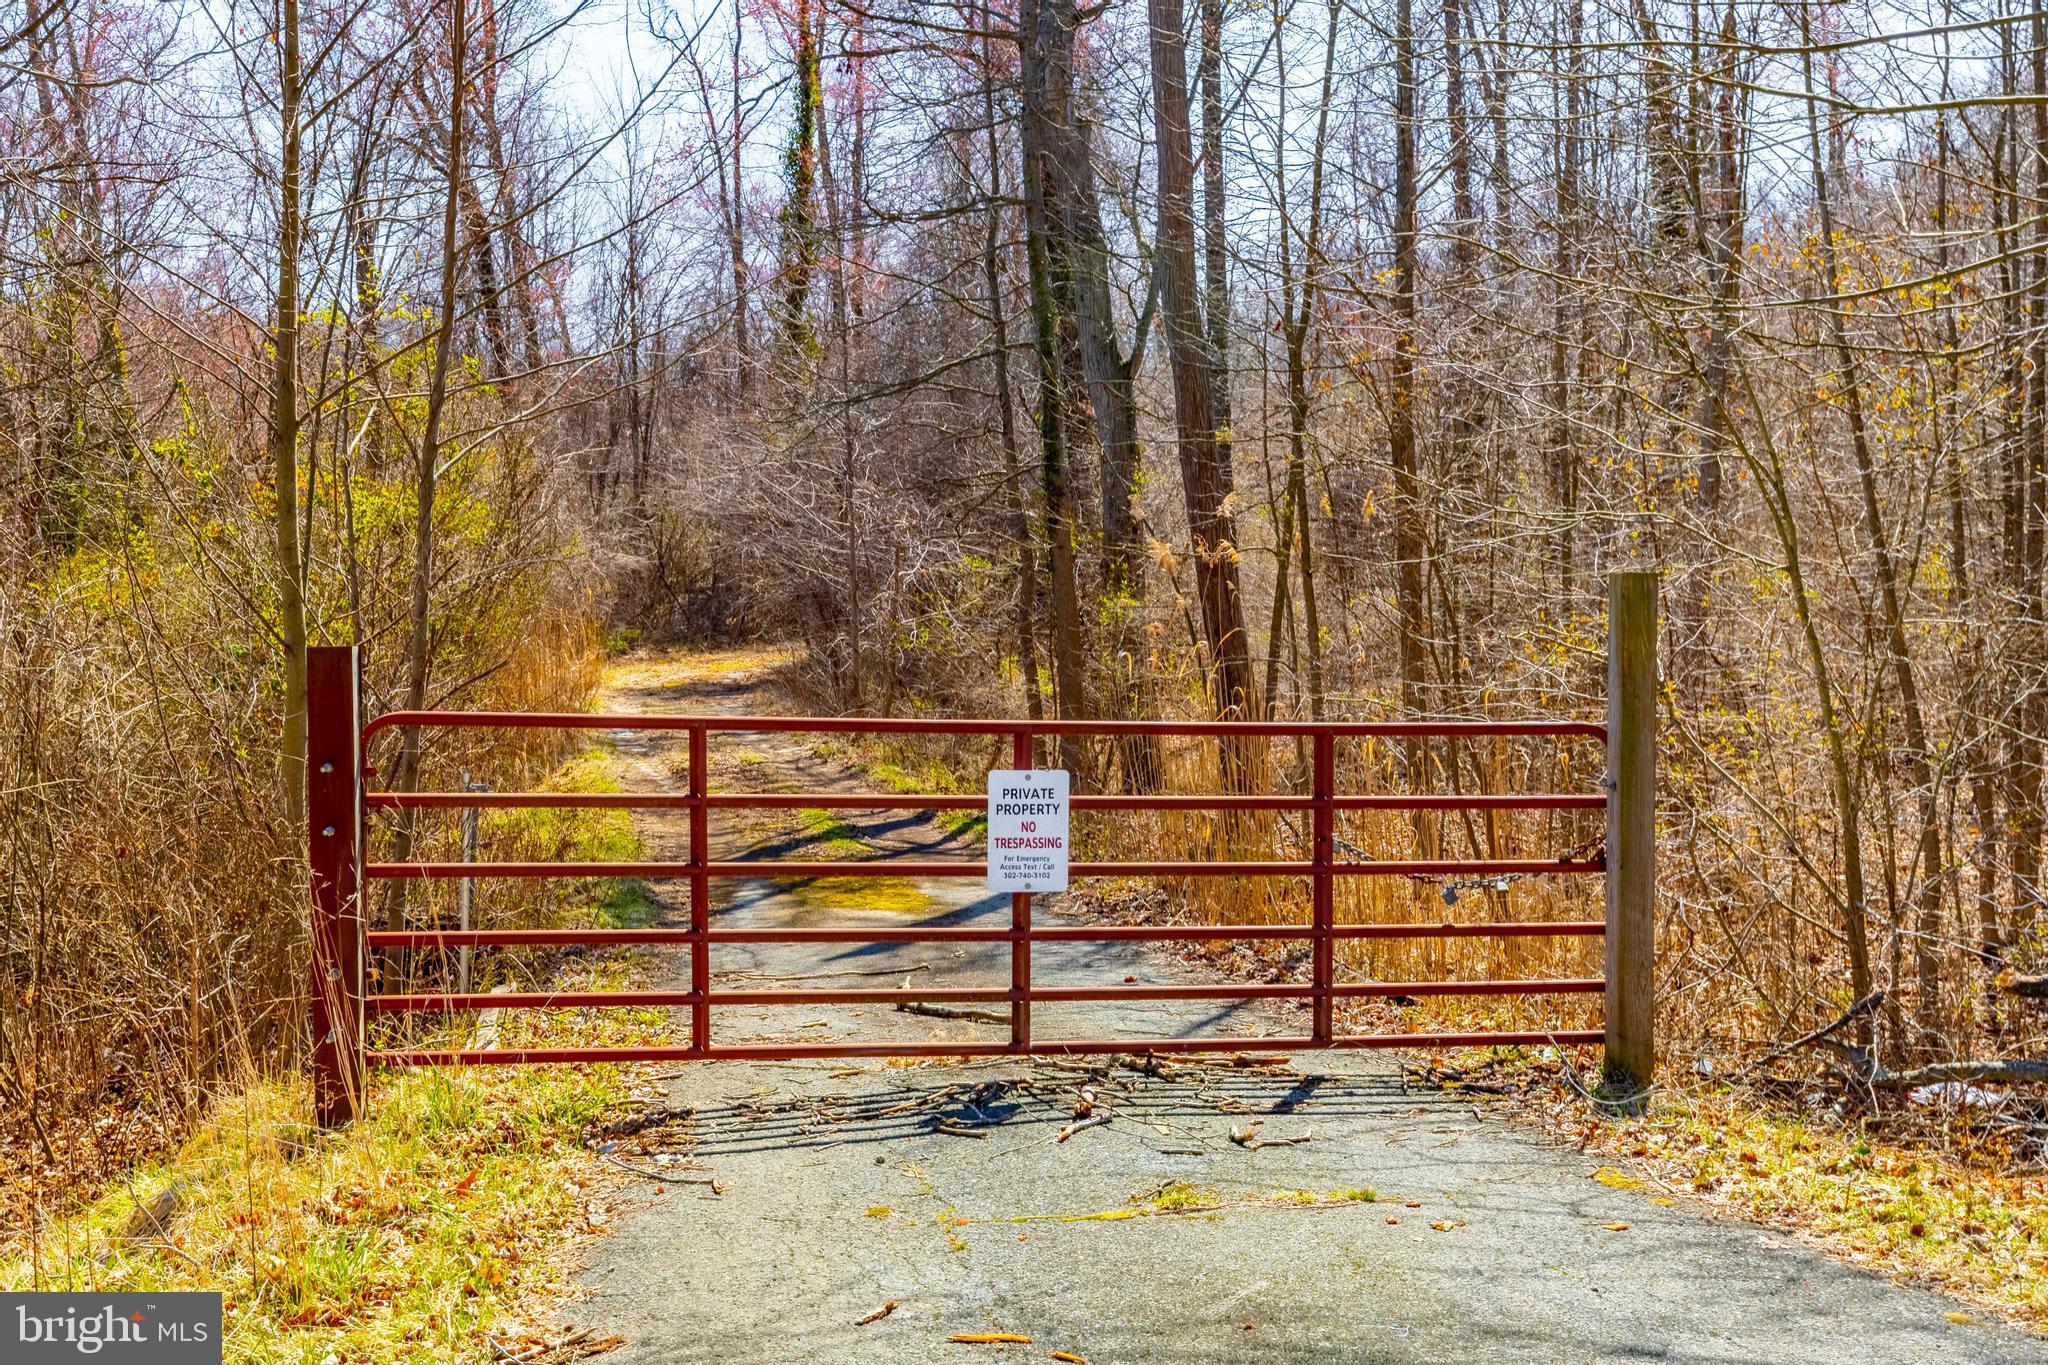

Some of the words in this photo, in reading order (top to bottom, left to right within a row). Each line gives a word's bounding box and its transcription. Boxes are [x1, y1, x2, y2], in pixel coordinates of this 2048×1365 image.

[1002, 788, 1054, 800] PRIVATE
[996, 804, 1060, 816] PROPERTY
[1021, 821, 1036, 832] NO
[995, 837, 1062, 849] TRESPASSING
